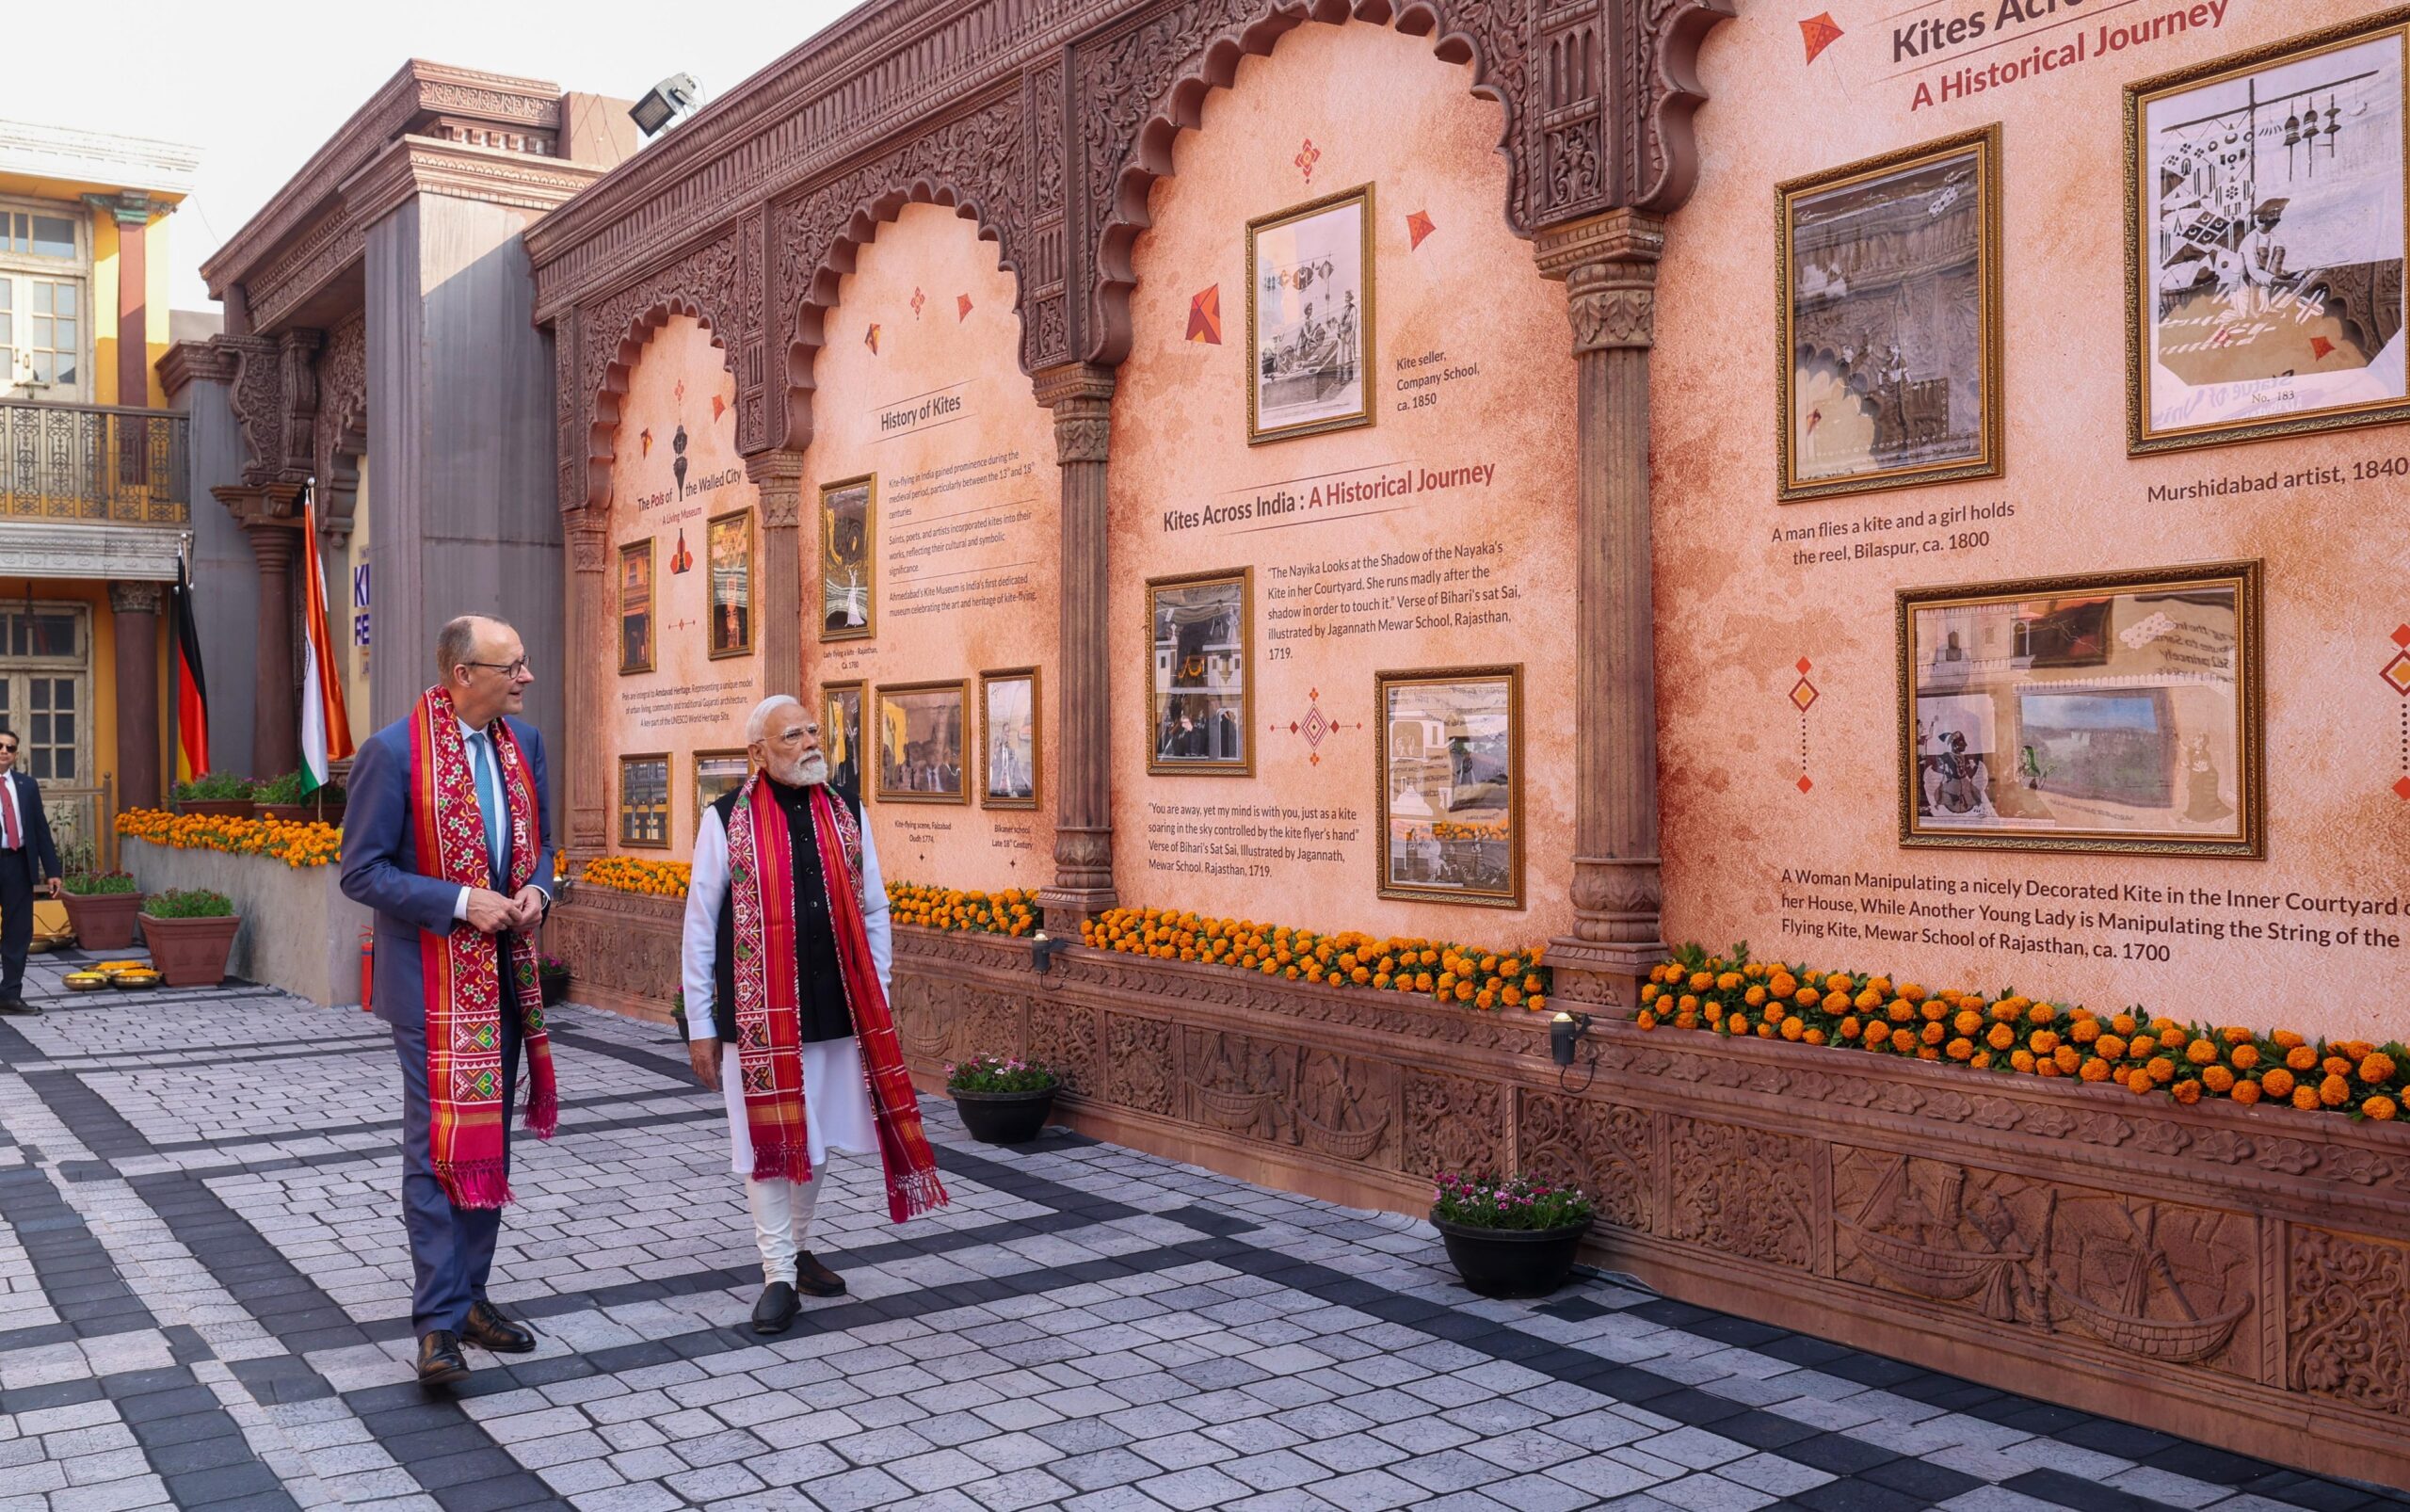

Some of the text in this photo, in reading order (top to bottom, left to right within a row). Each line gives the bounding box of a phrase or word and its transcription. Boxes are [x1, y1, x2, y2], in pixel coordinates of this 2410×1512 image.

[1893, 10, 1986, 63] Kites
[1911, 0, 2228, 112] A Historical Journey
[1396, 351, 1447, 371] Kite seller,
[1397, 373, 1441, 391] Company
[2252, 391, 2295, 404] No. 183
[881, 396, 960, 431] History of Kites
[1397, 393, 1437, 411] ca. 1850
[637, 468, 742, 512] The Pols of the Walled City
[2148, 457, 2409, 503] Murshidabad artist, 1840
[1164, 463, 1495, 531] Kites Across India A Historical Journey
[1771, 501, 2015, 542] A man flies a kite and a girl holds
[1289, 562, 1320, 577] Nayika
[1322, 558, 1349, 572] Looks
[1350, 557, 1360, 570] at
[1362, 555, 1378, 568] the
[1380, 551, 1420, 566] Shadow
[1422, 547, 1433, 561] of
[1434, 546, 1452, 559] the
[1792, 530, 1989, 565] the reel, Bilaspur, ca. 1800
[1267, 566, 1490, 599] Kite in her Courtyard. She runs madly after the
[1267, 606, 1301, 619] shadow
[1302, 604, 1311, 616] in
[1312, 602, 1339, 616] order
[1340, 602, 1350, 613] to
[1352, 598, 1379, 612] touch
[1396, 595, 1425, 607] Verse
[1427, 591, 1438, 605] of
[1482, 587, 1499, 601] sat
[1268, 624, 1312, 639] illustrated
[1314, 624, 1326, 638] by
[1326, 619, 1375, 636] Jagannath
[1377, 619, 1413, 631] Mewar
[1454, 611, 1511, 627] Rajasthan,
[1269, 647, 1293, 660] 1719.
[1166, 805, 1179, 814] are
[1202, 805, 1215, 817] yet
[1217, 807, 1229, 817] my
[1230, 804, 1251, 816] mind
[1253, 805, 1260, 816] is
[1261, 805, 1279, 817] with
[1281, 809, 1300, 820] you,
[1300, 806, 1318, 821] just
[1319, 810, 1329, 819] as
[1330, 810, 1336, 819] a
[1338, 807, 1357, 820] kite
[1148, 822, 1175, 835] soaring
[1176, 822, 1183, 832] in
[1184, 823, 1197, 834] the
[1198, 823, 1213, 836] sky
[1213, 825, 1256, 836] controlled
[1257, 825, 1267, 839] by
[1268, 826, 1283, 838] the
[1284, 826, 1301, 838] kite
[1148, 840, 1169, 851] Verse
[1170, 841, 1179, 852] of
[1209, 843, 1223, 854] Sat
[1240, 844, 1283, 858] Illustrated
[1284, 846, 1295, 861] by
[1296, 847, 1344, 862] Jagannath,
[1149, 858, 1174, 870] Mewar
[1204, 861, 1246, 876] Rajasthan,
[1248, 864, 1272, 877] 1719.
[1780, 868, 1791, 882] A
[1794, 869, 1850, 885] Woman
[1855, 872, 1956, 894] Manipulating
[1959, 880, 1968, 892] a
[1972, 877, 2021, 897] nicely
[2026, 879, 2118, 900] Decorated
[2123, 884, 2161, 902] Kite
[2167, 886, 2183, 904] in
[2188, 887, 2221, 906] the
[2226, 889, 2280, 909] Inner
[2285, 893, 2397, 916] Courtyard
[1781, 893, 2400, 947] her House, While Another Young Lady is Manipulating the String of the
[1781, 918, 2170, 961] Flying Kite, Mewar School of Rajasthan, ca. 1700
